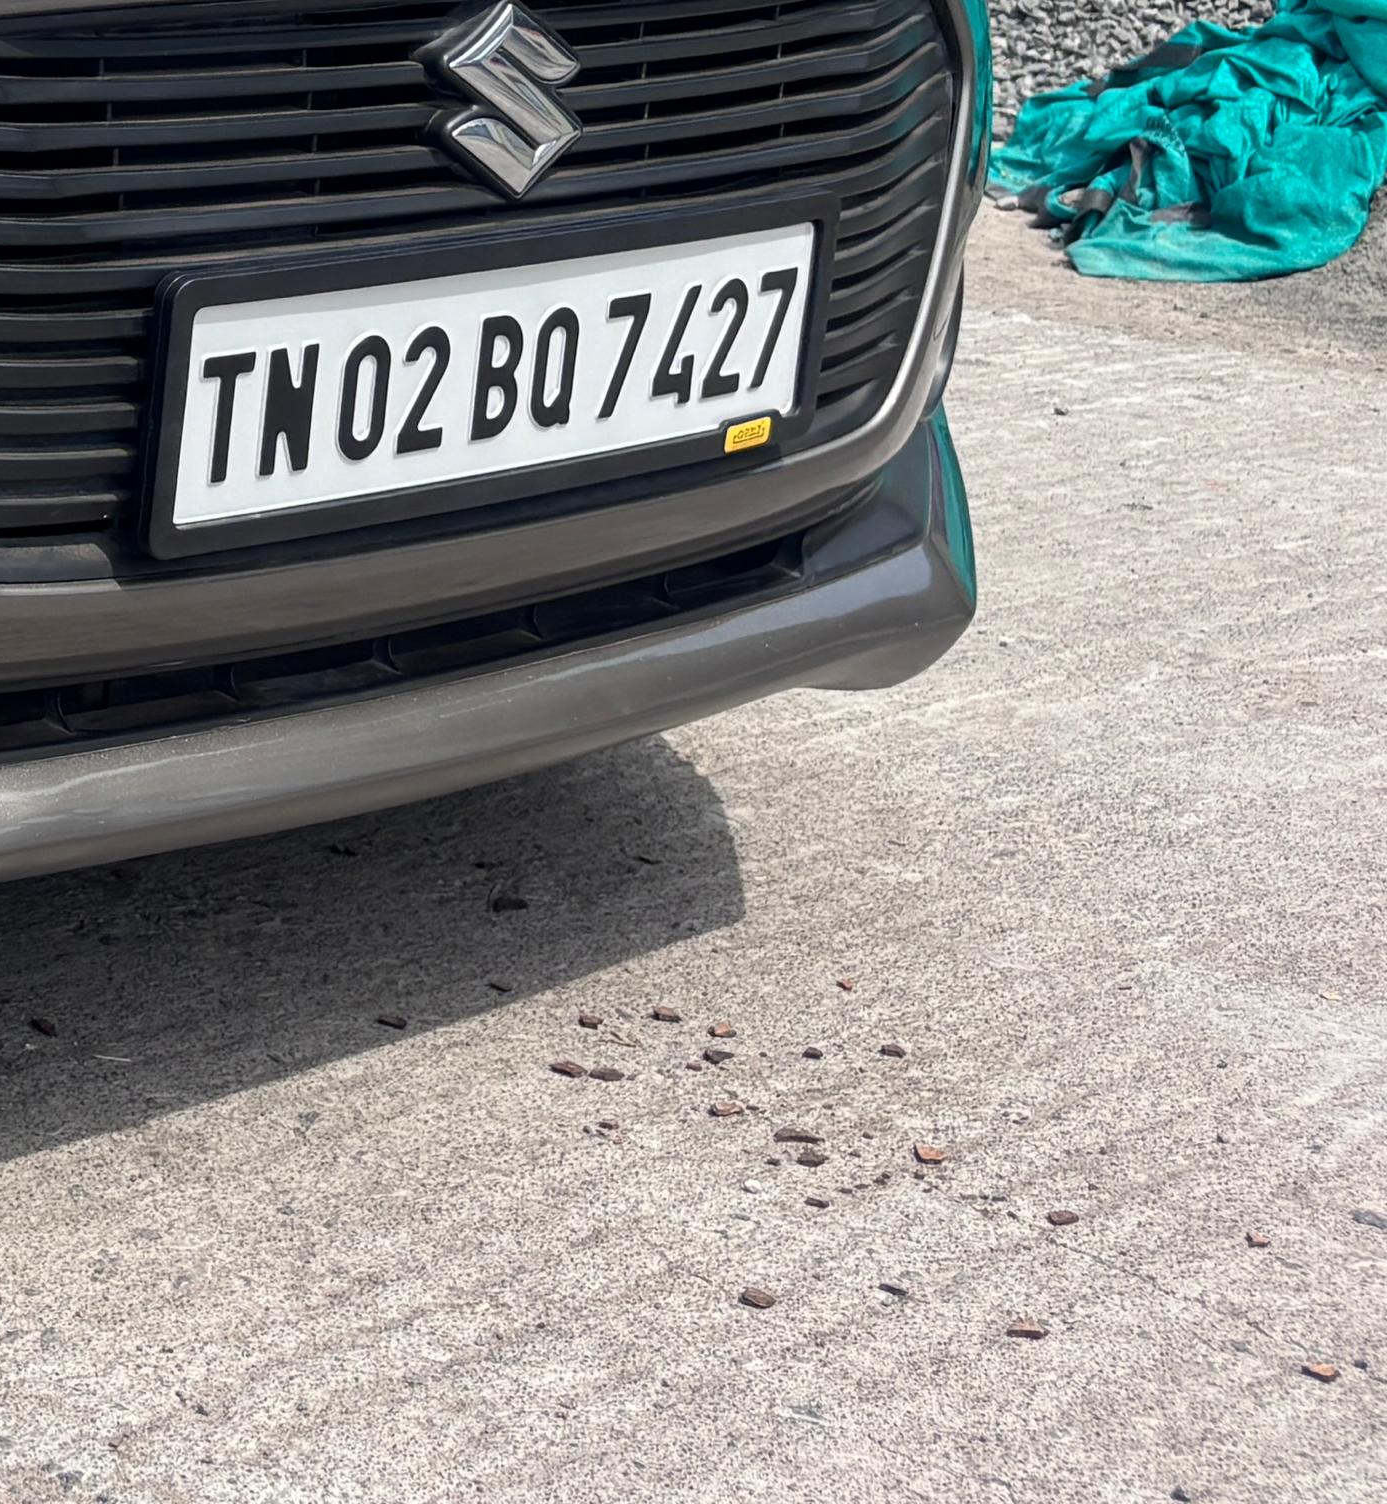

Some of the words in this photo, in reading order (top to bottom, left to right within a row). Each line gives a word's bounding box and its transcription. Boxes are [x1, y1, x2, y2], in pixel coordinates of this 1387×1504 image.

[202, 342, 321, 484] TN
[337, 326, 452, 462] 02
[469, 306, 581, 442] BQ
[597, 267, 799, 419] 7427
